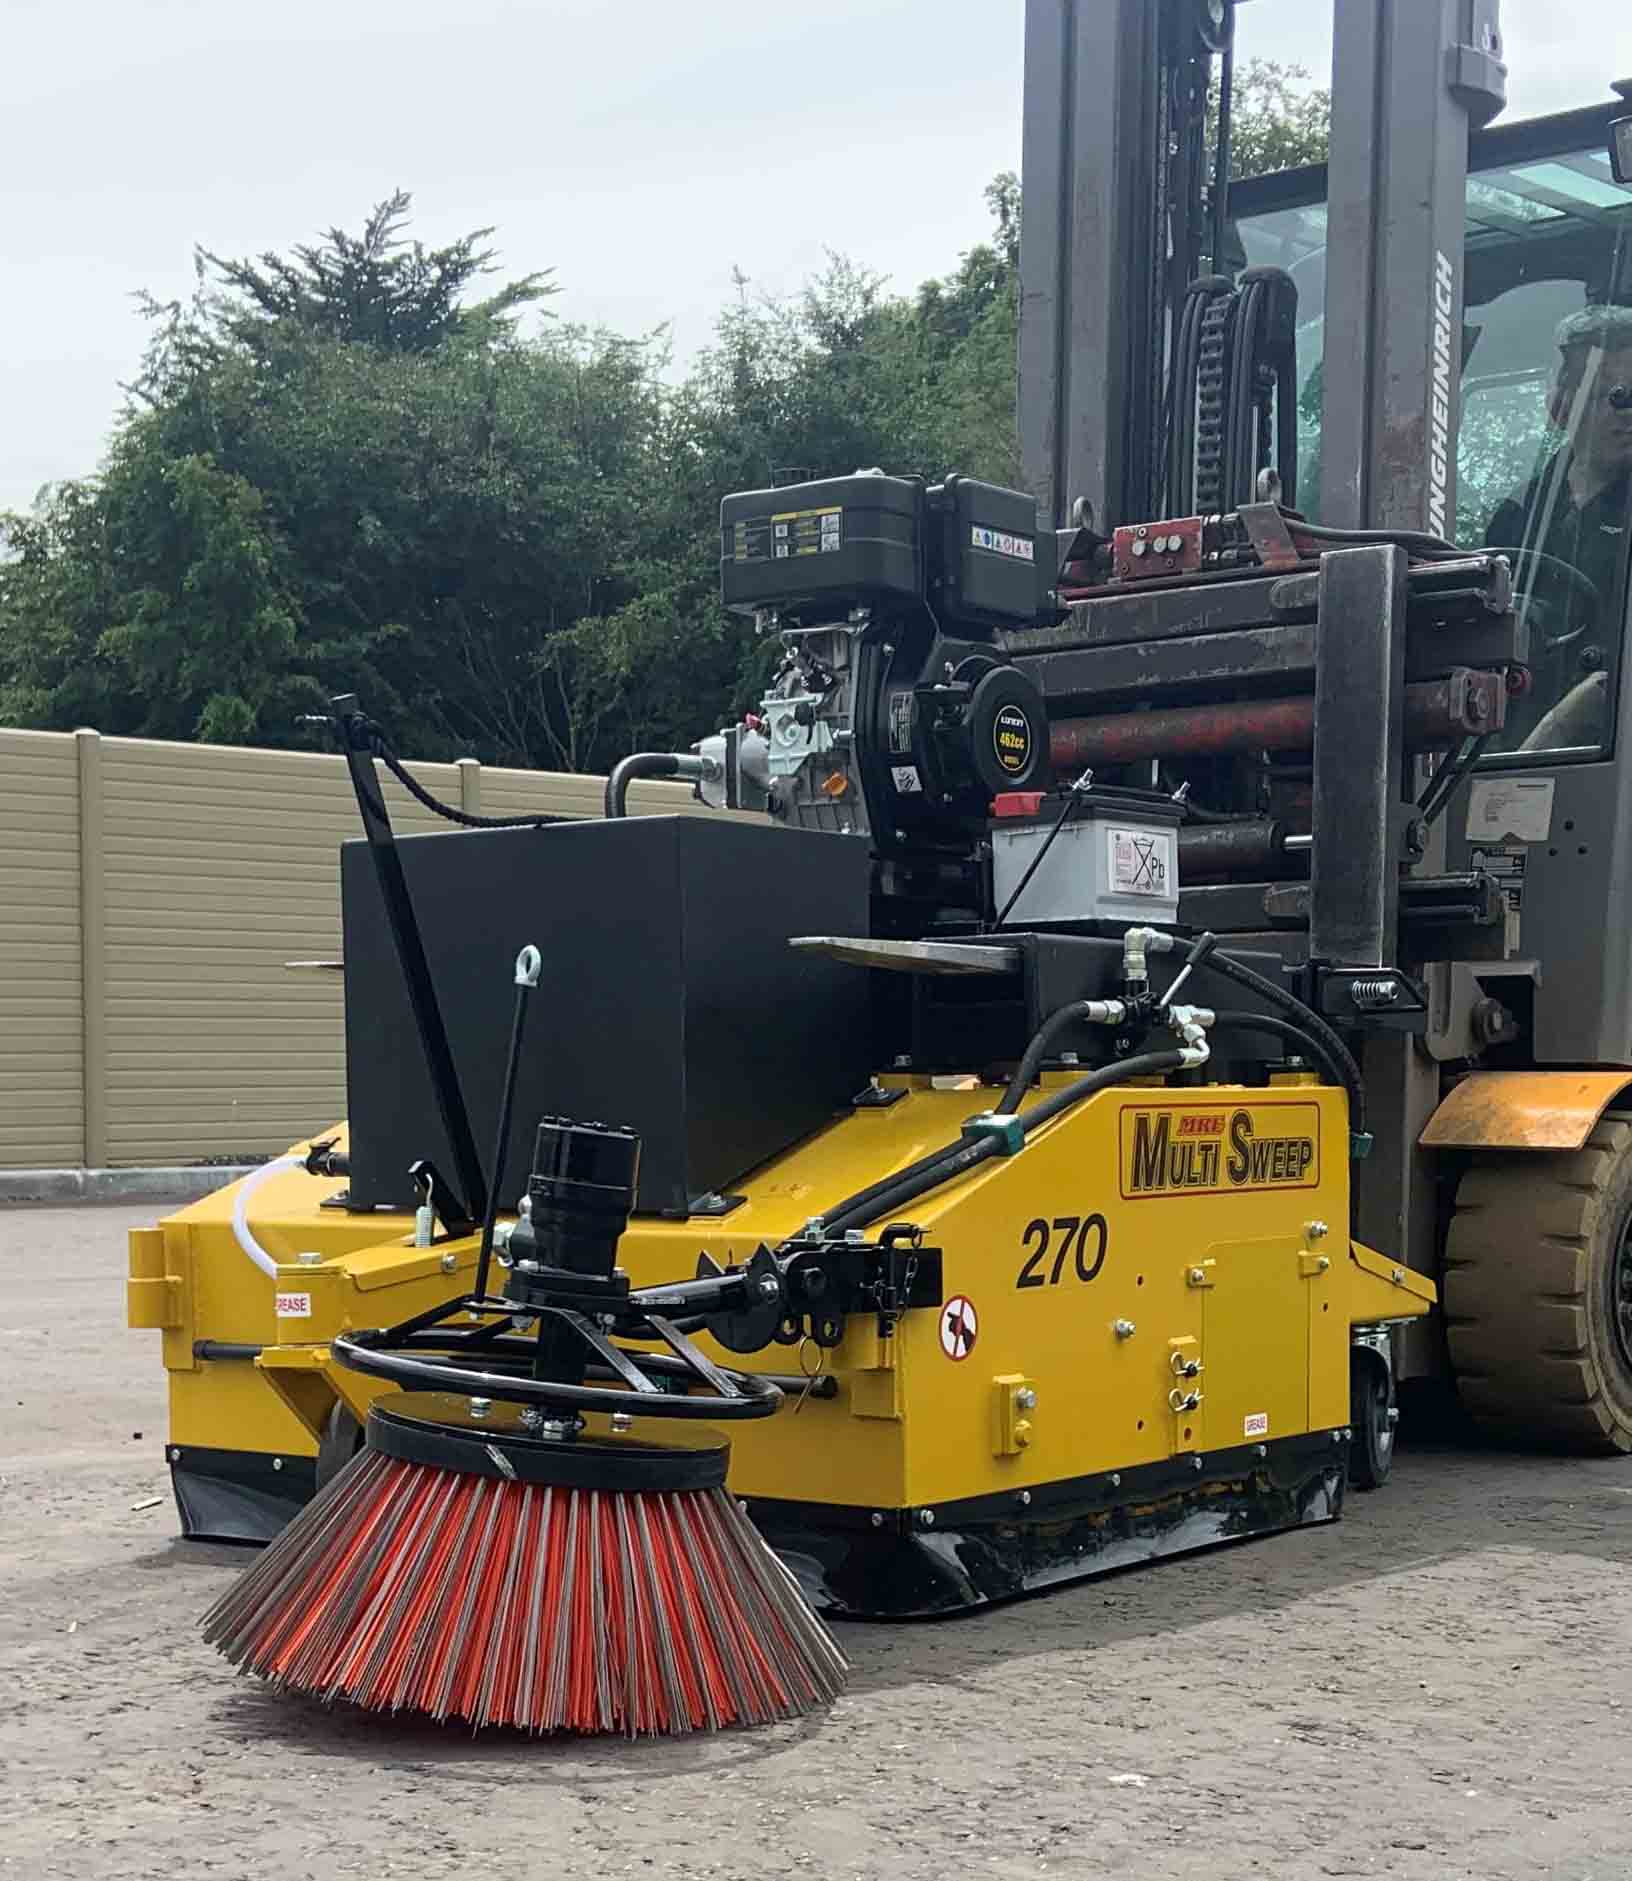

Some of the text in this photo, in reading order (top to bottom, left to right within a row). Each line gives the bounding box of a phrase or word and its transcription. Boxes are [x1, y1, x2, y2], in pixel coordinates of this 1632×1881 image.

[1429, 250, 1453, 540] UNGHEINRICH
[1000, 732, 1025, 750] 462cc
[1151, 856, 1165, 879] Pb
[1131, 1109, 1313, 1192] MULTI SWEEP
[1016, 1213, 1108, 1289] 270
[277, 1297, 307, 1312] REASE
